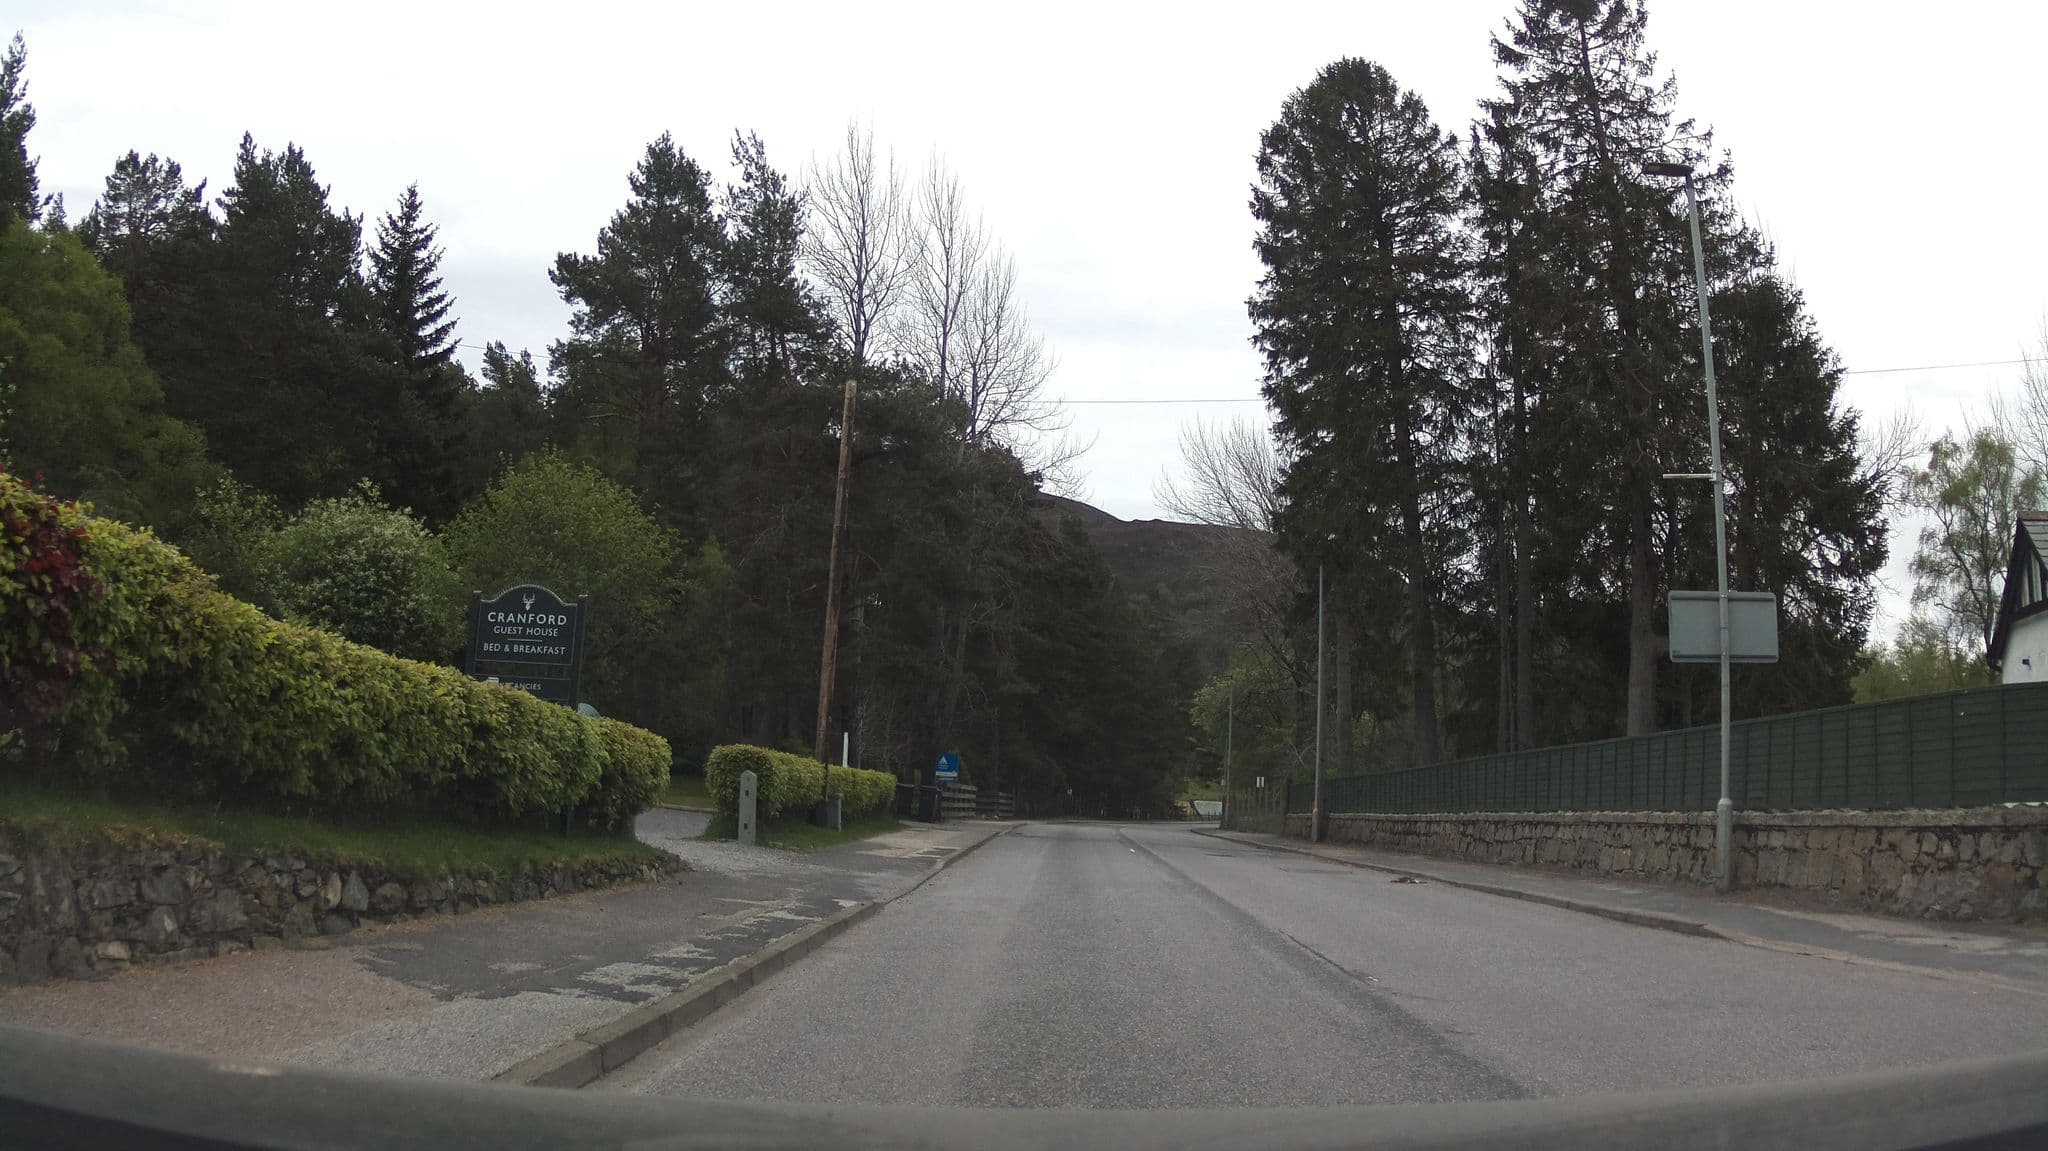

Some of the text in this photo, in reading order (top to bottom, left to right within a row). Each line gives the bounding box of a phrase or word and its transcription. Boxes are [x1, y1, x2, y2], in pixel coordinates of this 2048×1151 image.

[487, 611, 567, 625] CRANFORD
[493, 626, 559, 637] GUEST HOUSE
[483, 643, 501, 652] BED
[513, 644, 566, 655] BREAKFAST
[500, 682, 541, 690] ANCIES
